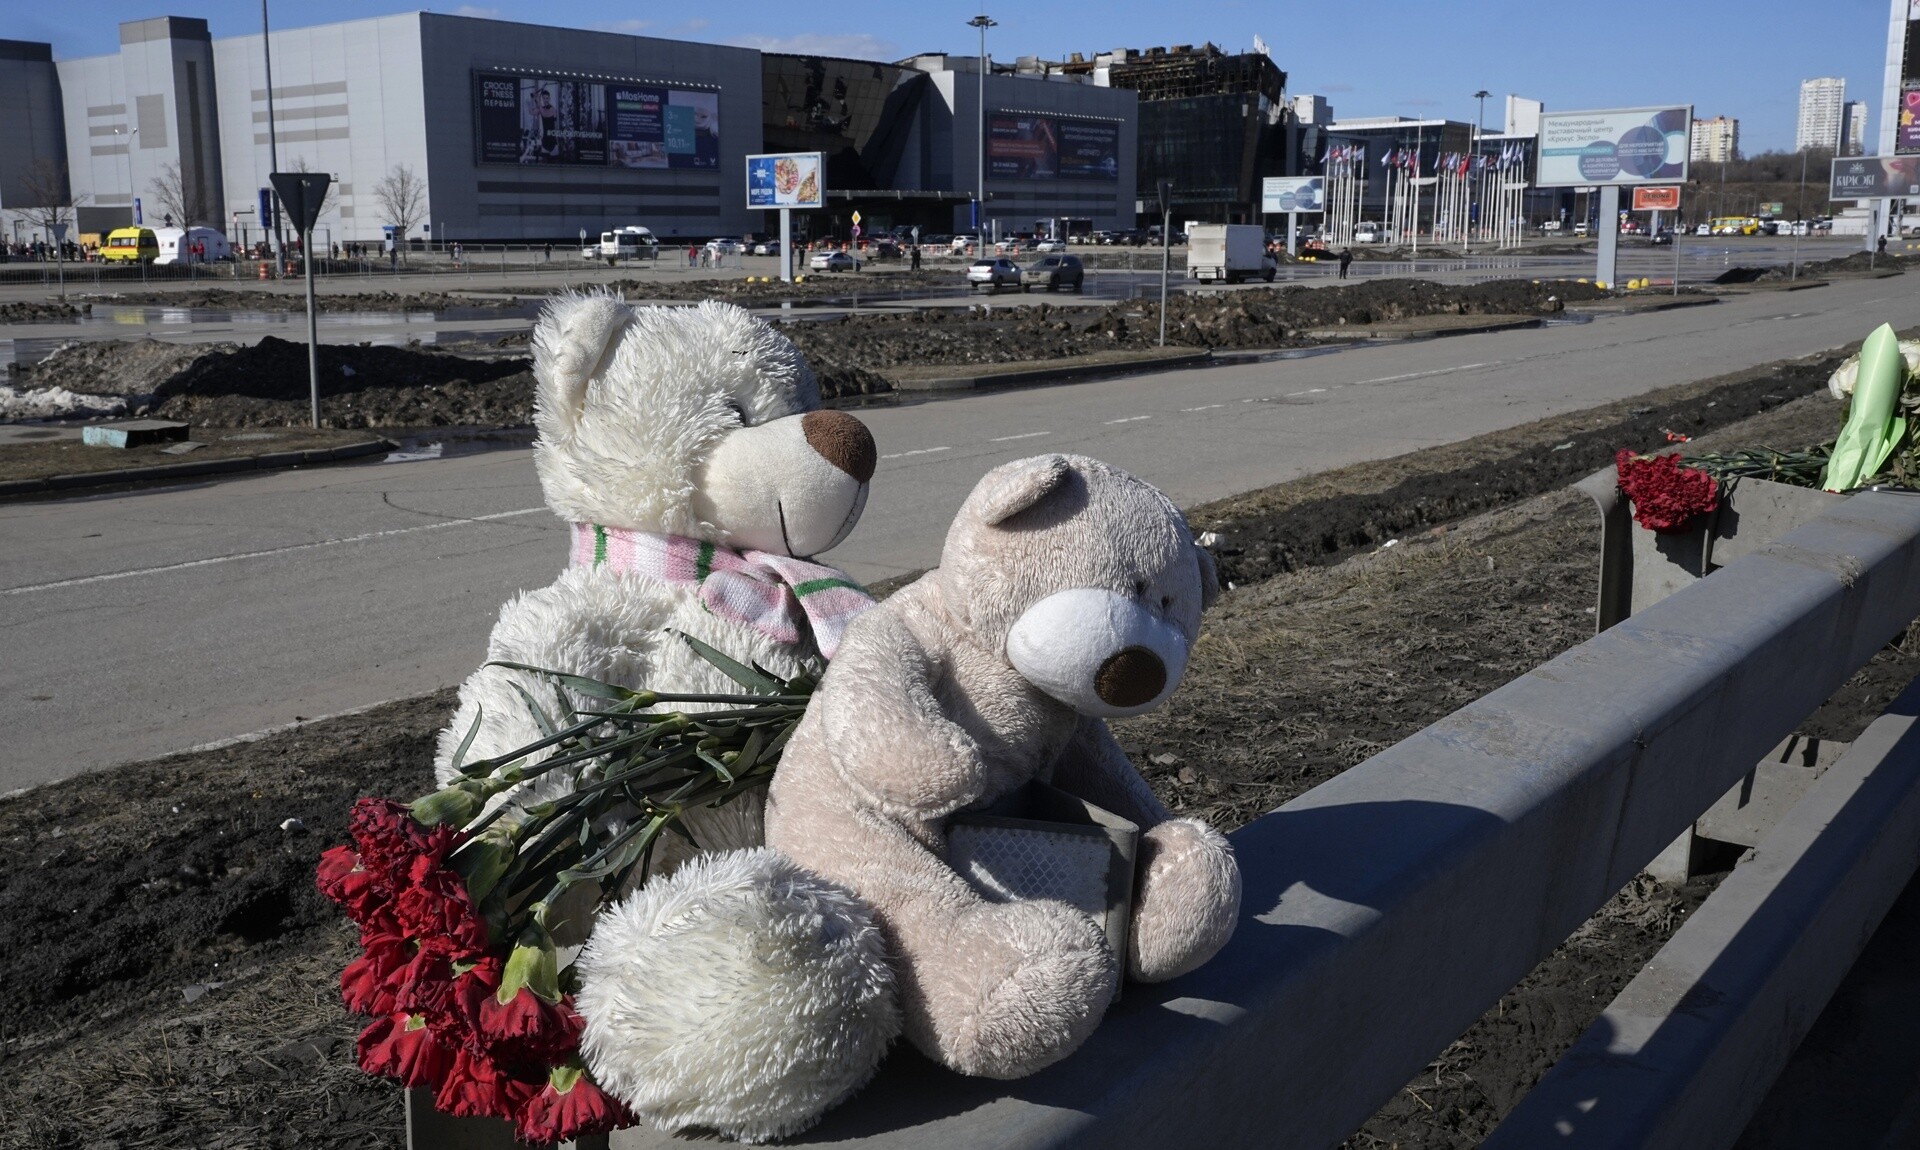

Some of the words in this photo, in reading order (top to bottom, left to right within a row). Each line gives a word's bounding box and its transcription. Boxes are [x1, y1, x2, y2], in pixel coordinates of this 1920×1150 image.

[484, 82, 514, 91] CROCUS
[484, 90, 514, 99] FTNESS
[622, 91, 660, 102] MosHome
[484, 99, 515, 107] ПЕРВЫЙ
[1548, 118, 1605, 127] Международный
[1548, 127, 1592, 135] выставочный
[1547, 135, 1575, 143] «Крокус
[1576, 134, 1600, 142] Экспо»
